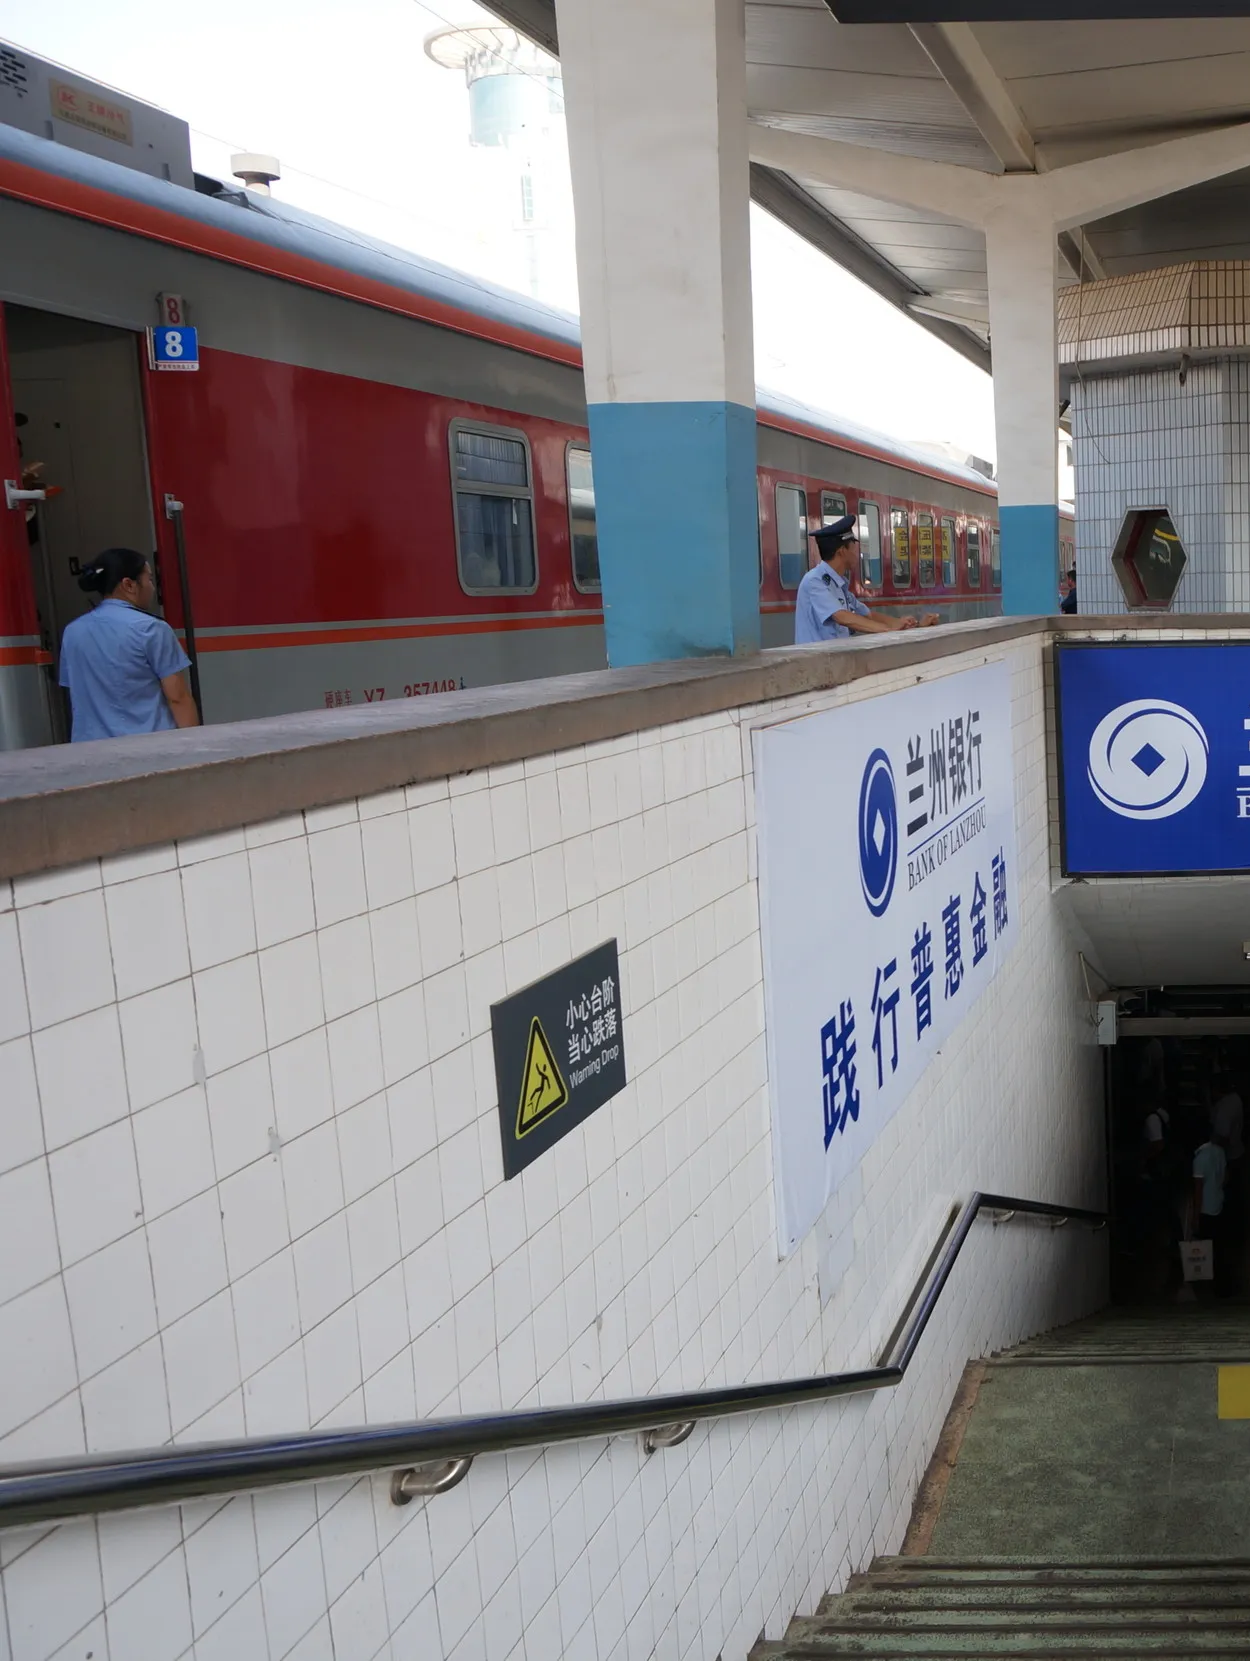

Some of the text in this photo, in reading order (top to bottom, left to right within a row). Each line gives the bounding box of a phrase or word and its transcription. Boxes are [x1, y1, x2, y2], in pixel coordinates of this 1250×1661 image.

[166, 297, 180, 324] 8
[165, 331, 183, 358] 8
[906, 709, 982, 837] 兰州银行
[907, 805, 987, 892] BANK OF LANZHOU
[566, 976, 615, 1030] 小心台阶
[819, 846, 1009, 1154] 践行普惠金融
[567, 1008, 617, 1065] 当心跌落
[601, 1045, 619, 1066] Drop
